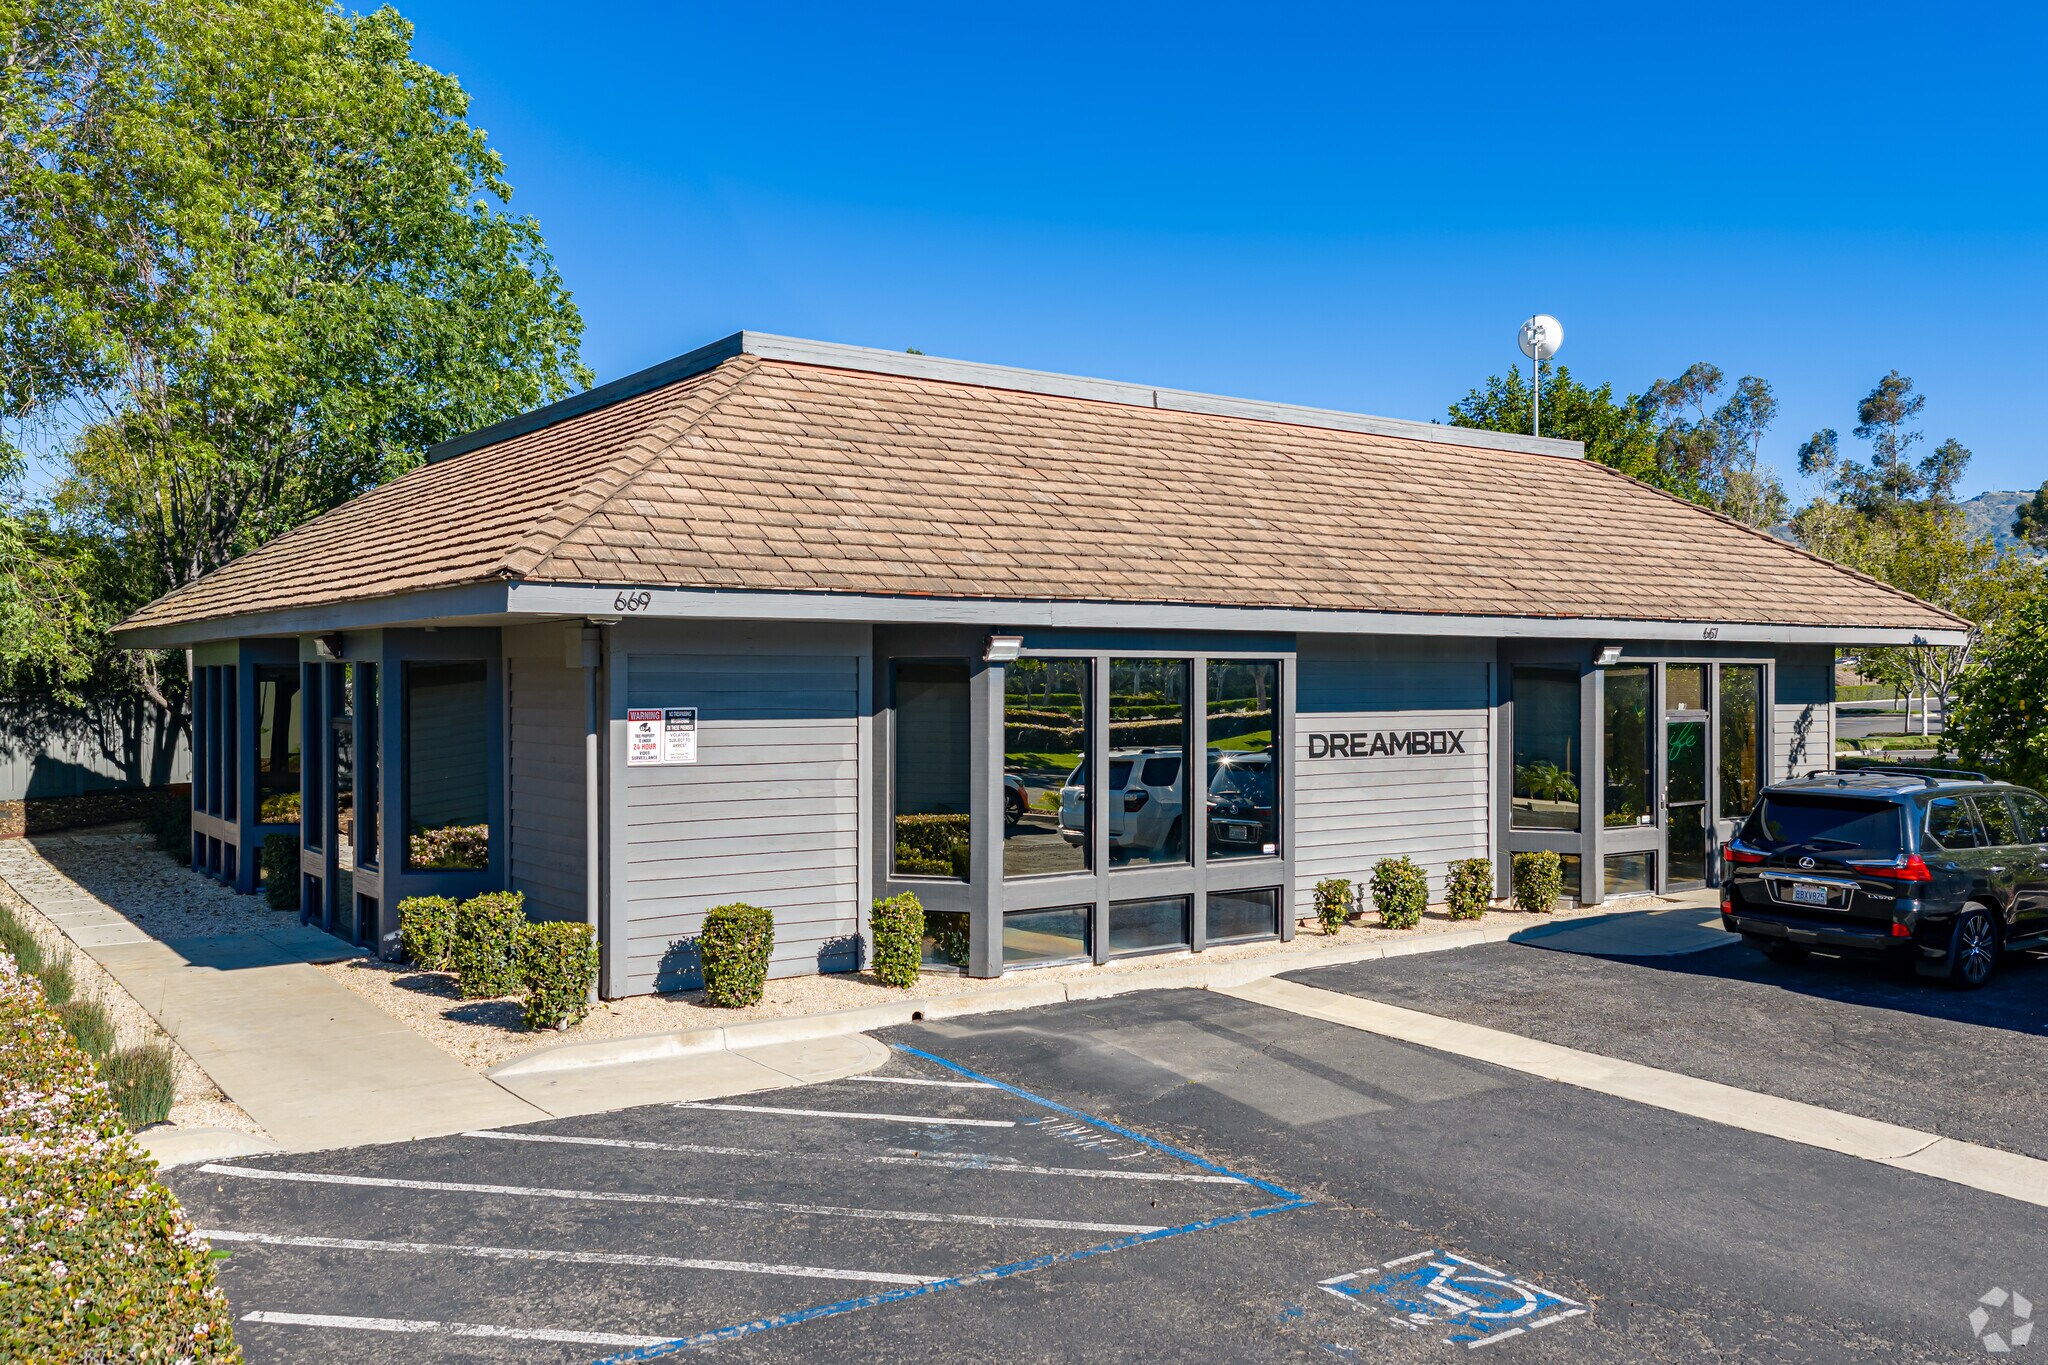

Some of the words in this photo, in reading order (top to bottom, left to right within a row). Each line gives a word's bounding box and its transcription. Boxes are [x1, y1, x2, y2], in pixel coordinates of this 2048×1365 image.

[614, 592, 651, 611] 669
[630, 711, 660, 720] WARNING
[1309, 730, 1465, 758] DREAMBOX
